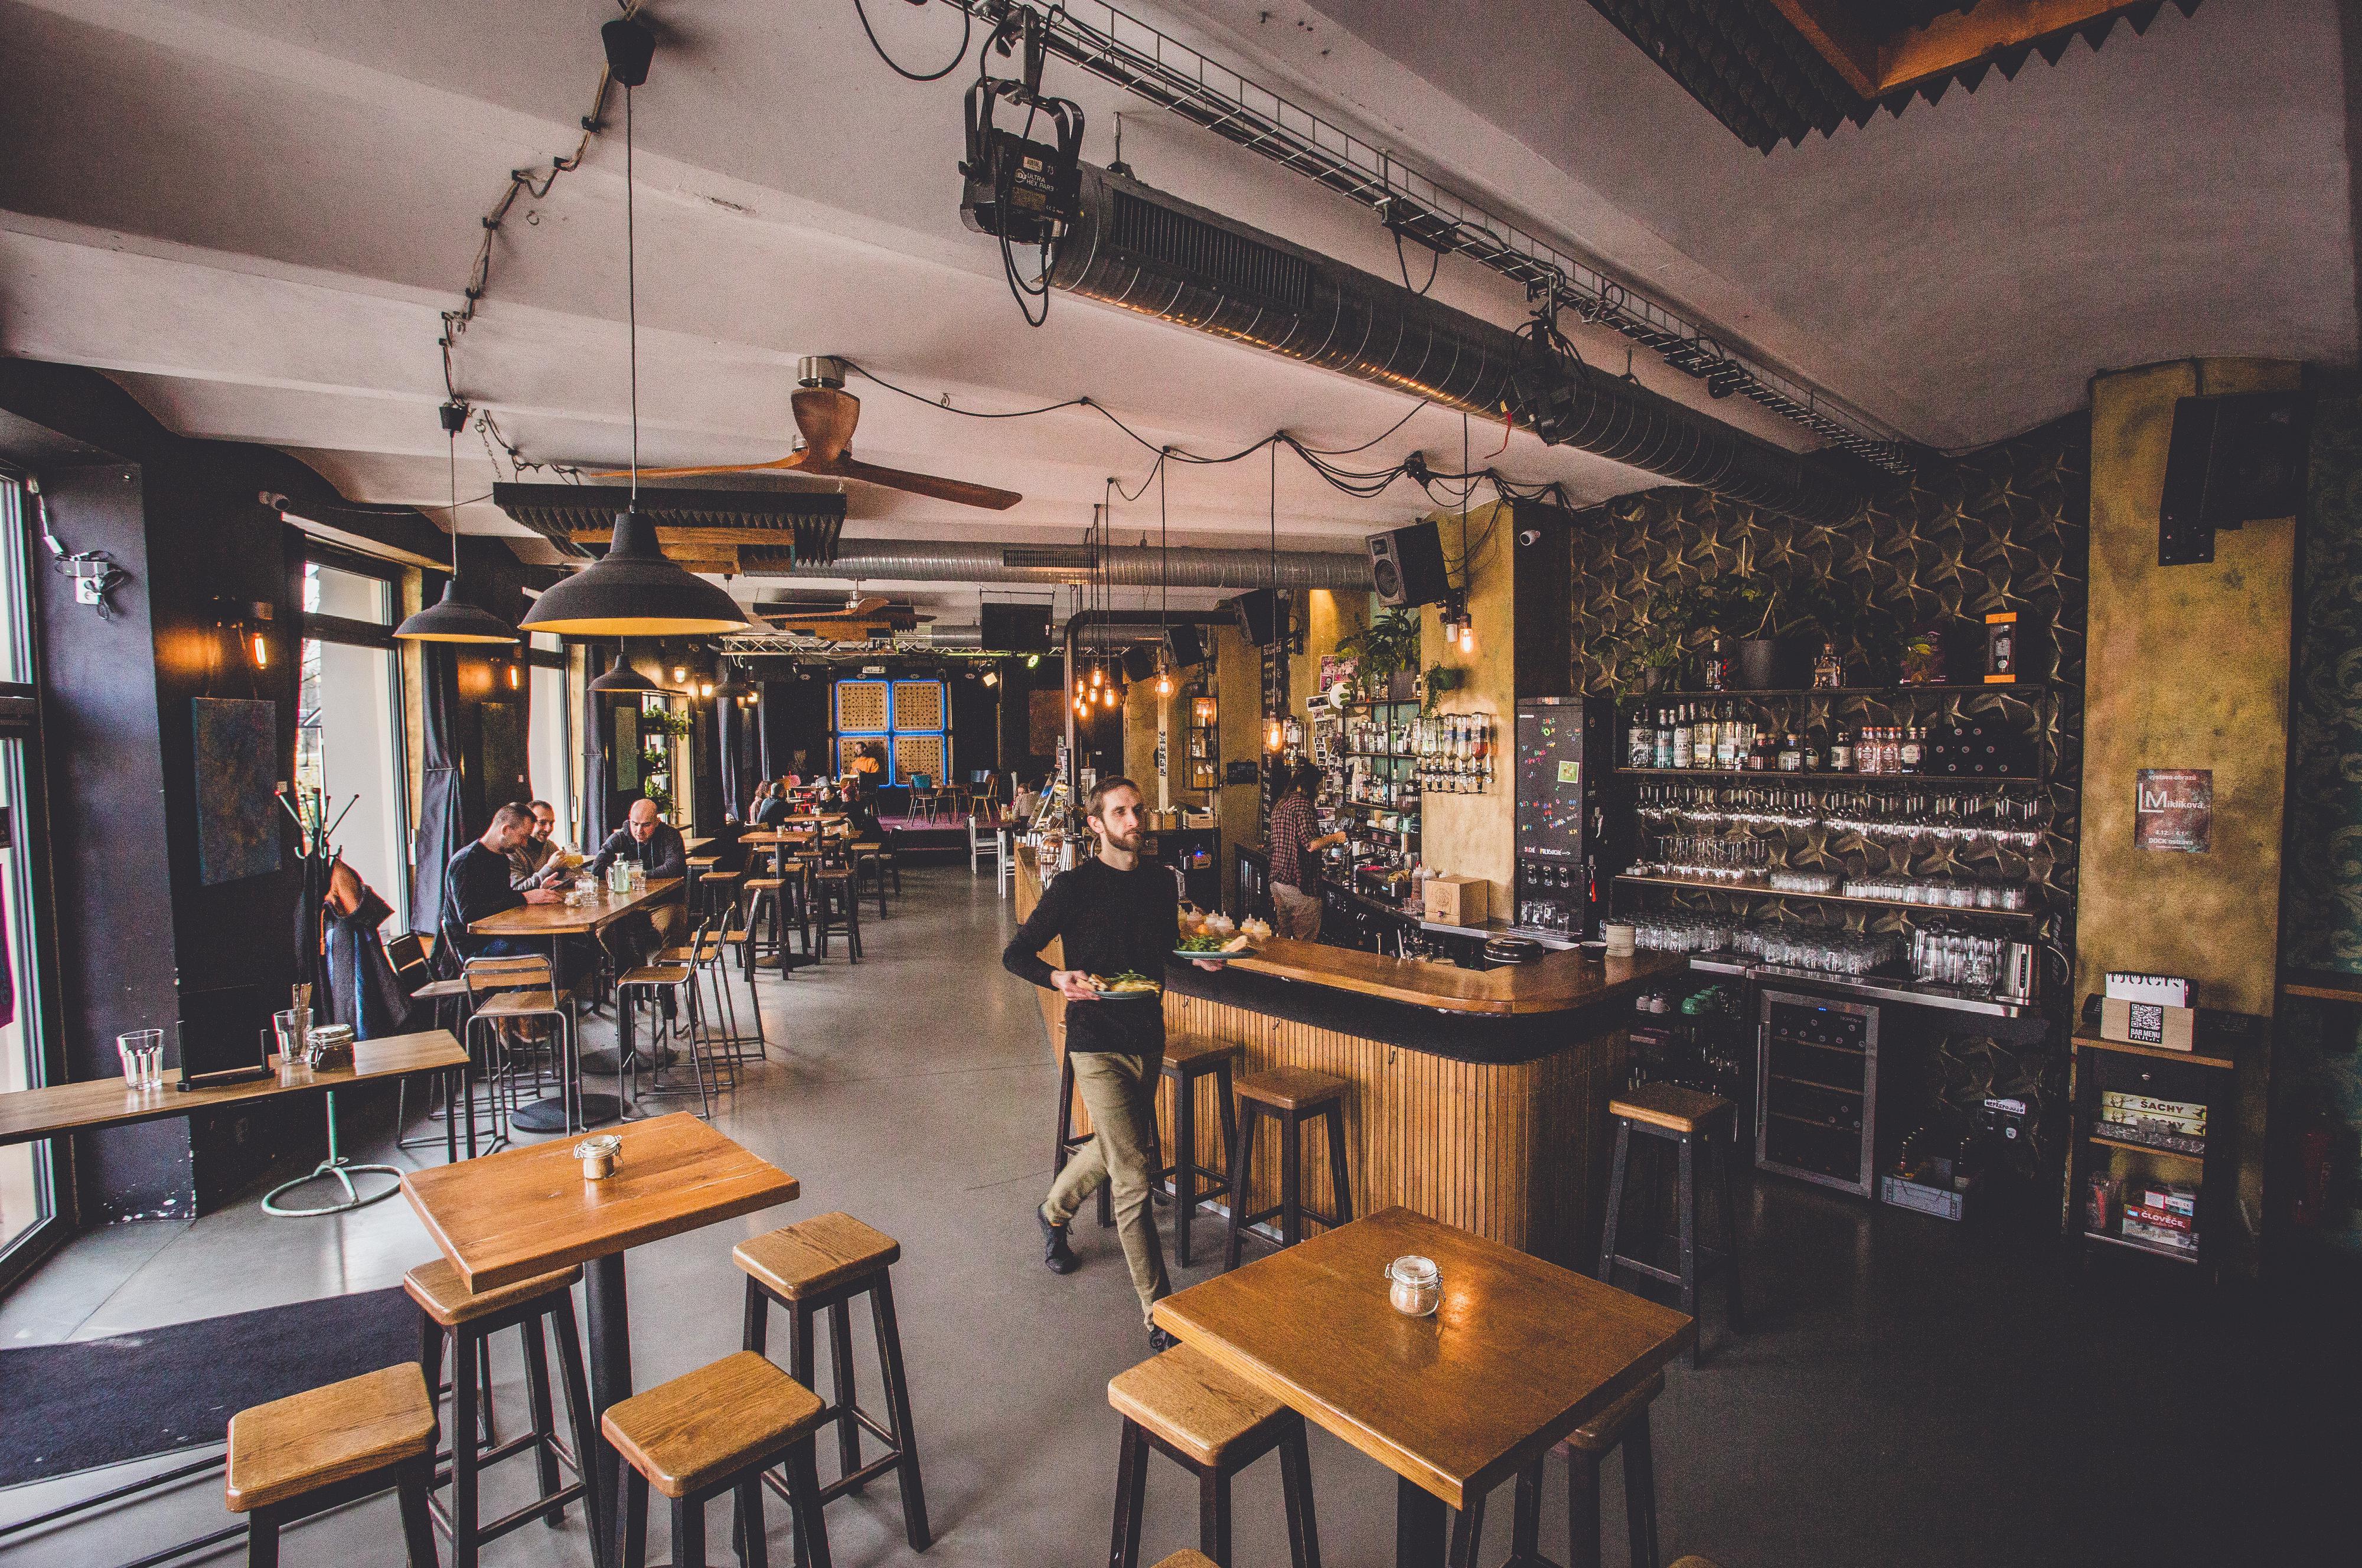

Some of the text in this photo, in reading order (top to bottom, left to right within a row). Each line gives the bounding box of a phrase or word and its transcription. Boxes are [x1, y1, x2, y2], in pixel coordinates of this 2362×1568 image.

[1027, 172, 1045, 183] ULTRA
[2143, 1030, 2160, 1038] MENU
[2141, 1098, 2184, 1113] ŠACHY
